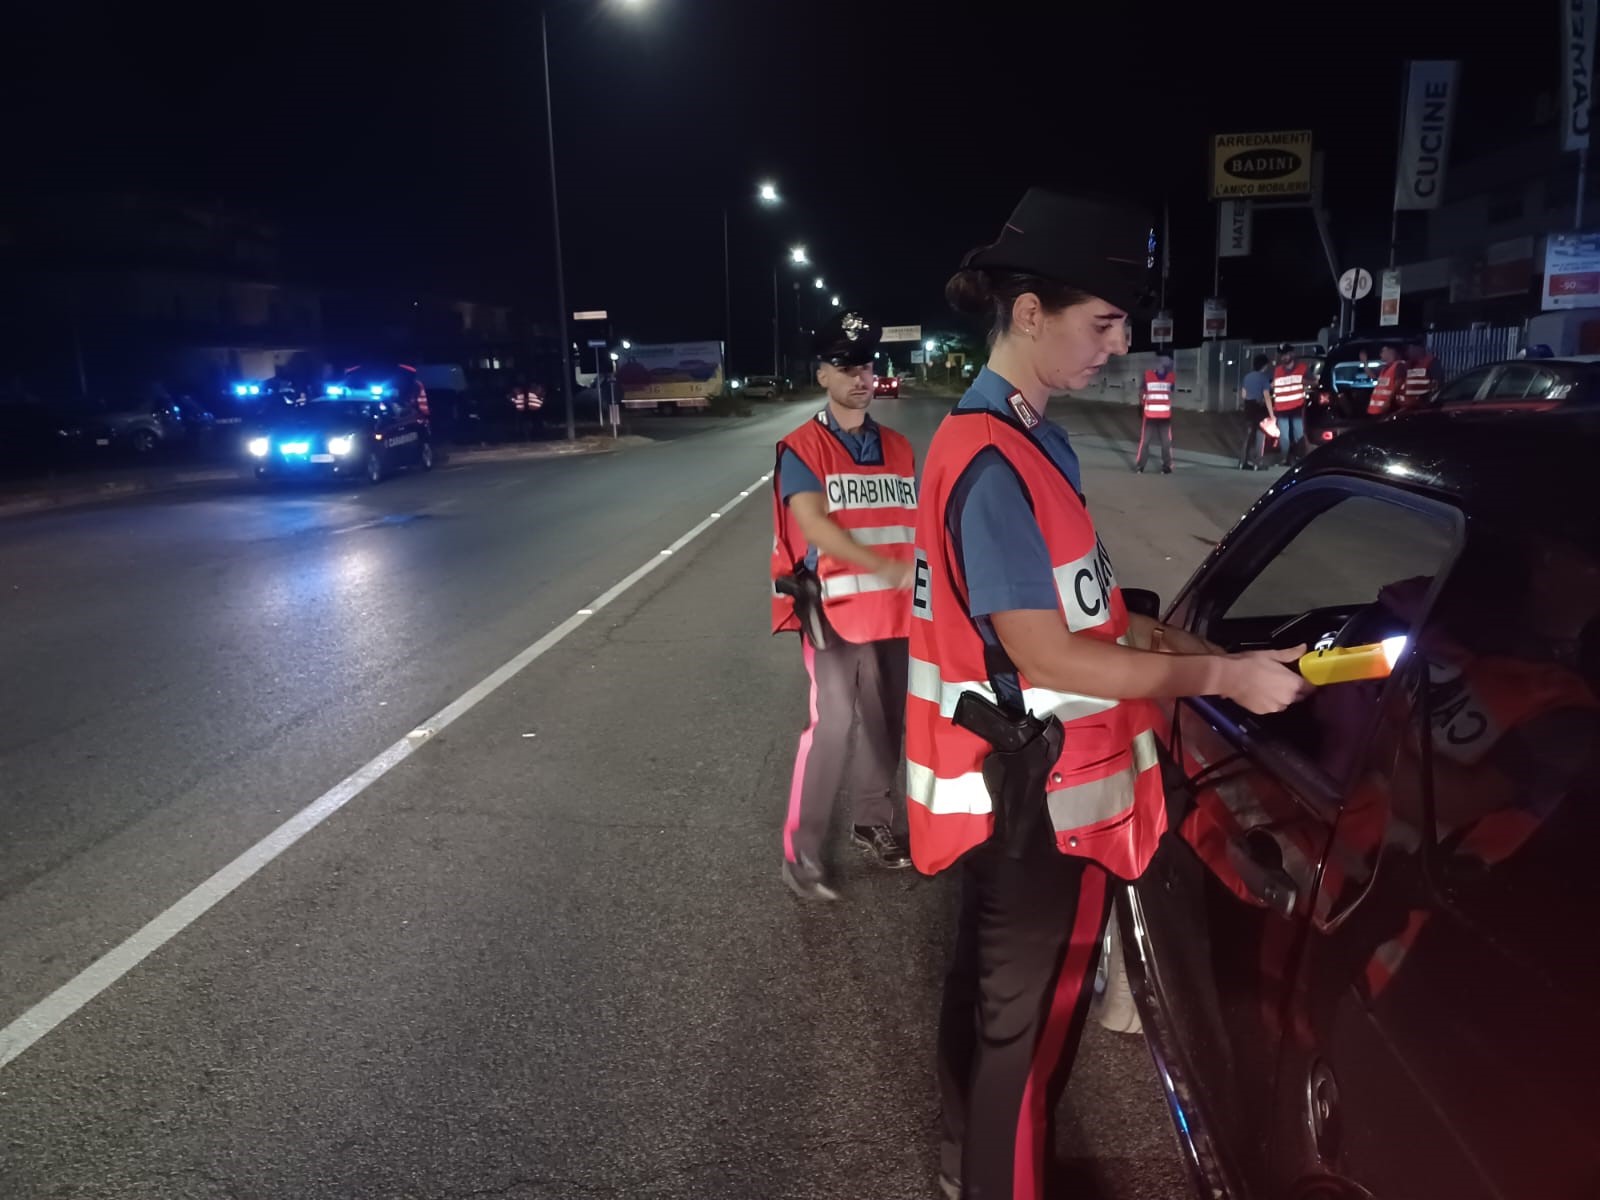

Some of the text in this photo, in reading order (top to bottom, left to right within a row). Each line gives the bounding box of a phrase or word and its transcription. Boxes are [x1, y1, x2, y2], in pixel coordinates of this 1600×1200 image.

[1216, 132, 1311, 146] ARREDAMENTI
[1414, 82, 1449, 198] CUCINE
[1231, 156, 1294, 172] BADINI
[1215, 183, 1254, 196] L'AMICO
